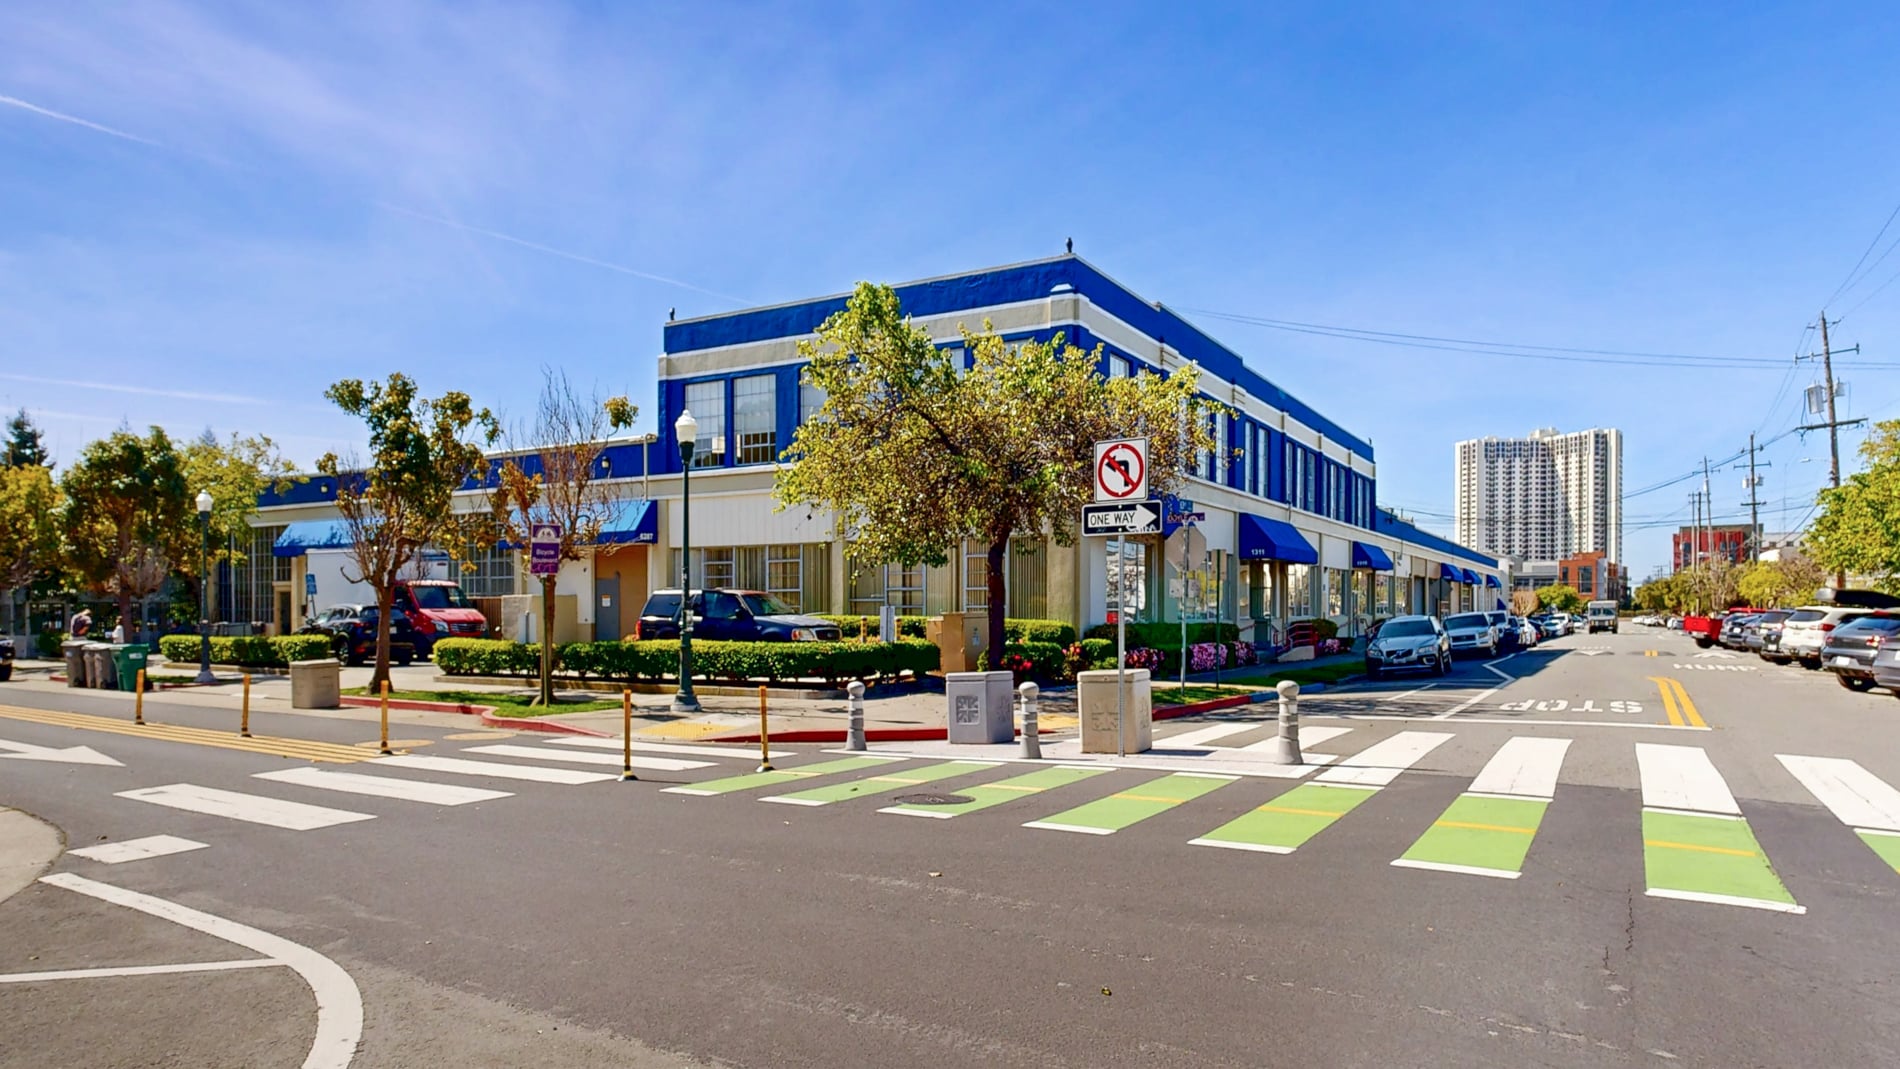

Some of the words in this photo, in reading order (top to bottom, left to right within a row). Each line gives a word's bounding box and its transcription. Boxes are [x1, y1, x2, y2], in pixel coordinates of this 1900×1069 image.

[1090, 513, 1111, 526] ONE
[1113, 511, 1136, 524] WAY
[1251, 548, 1265, 556] 1311
[1673, 663, 1758, 672] HUMP
[1498, 699, 1644, 714] STOP
